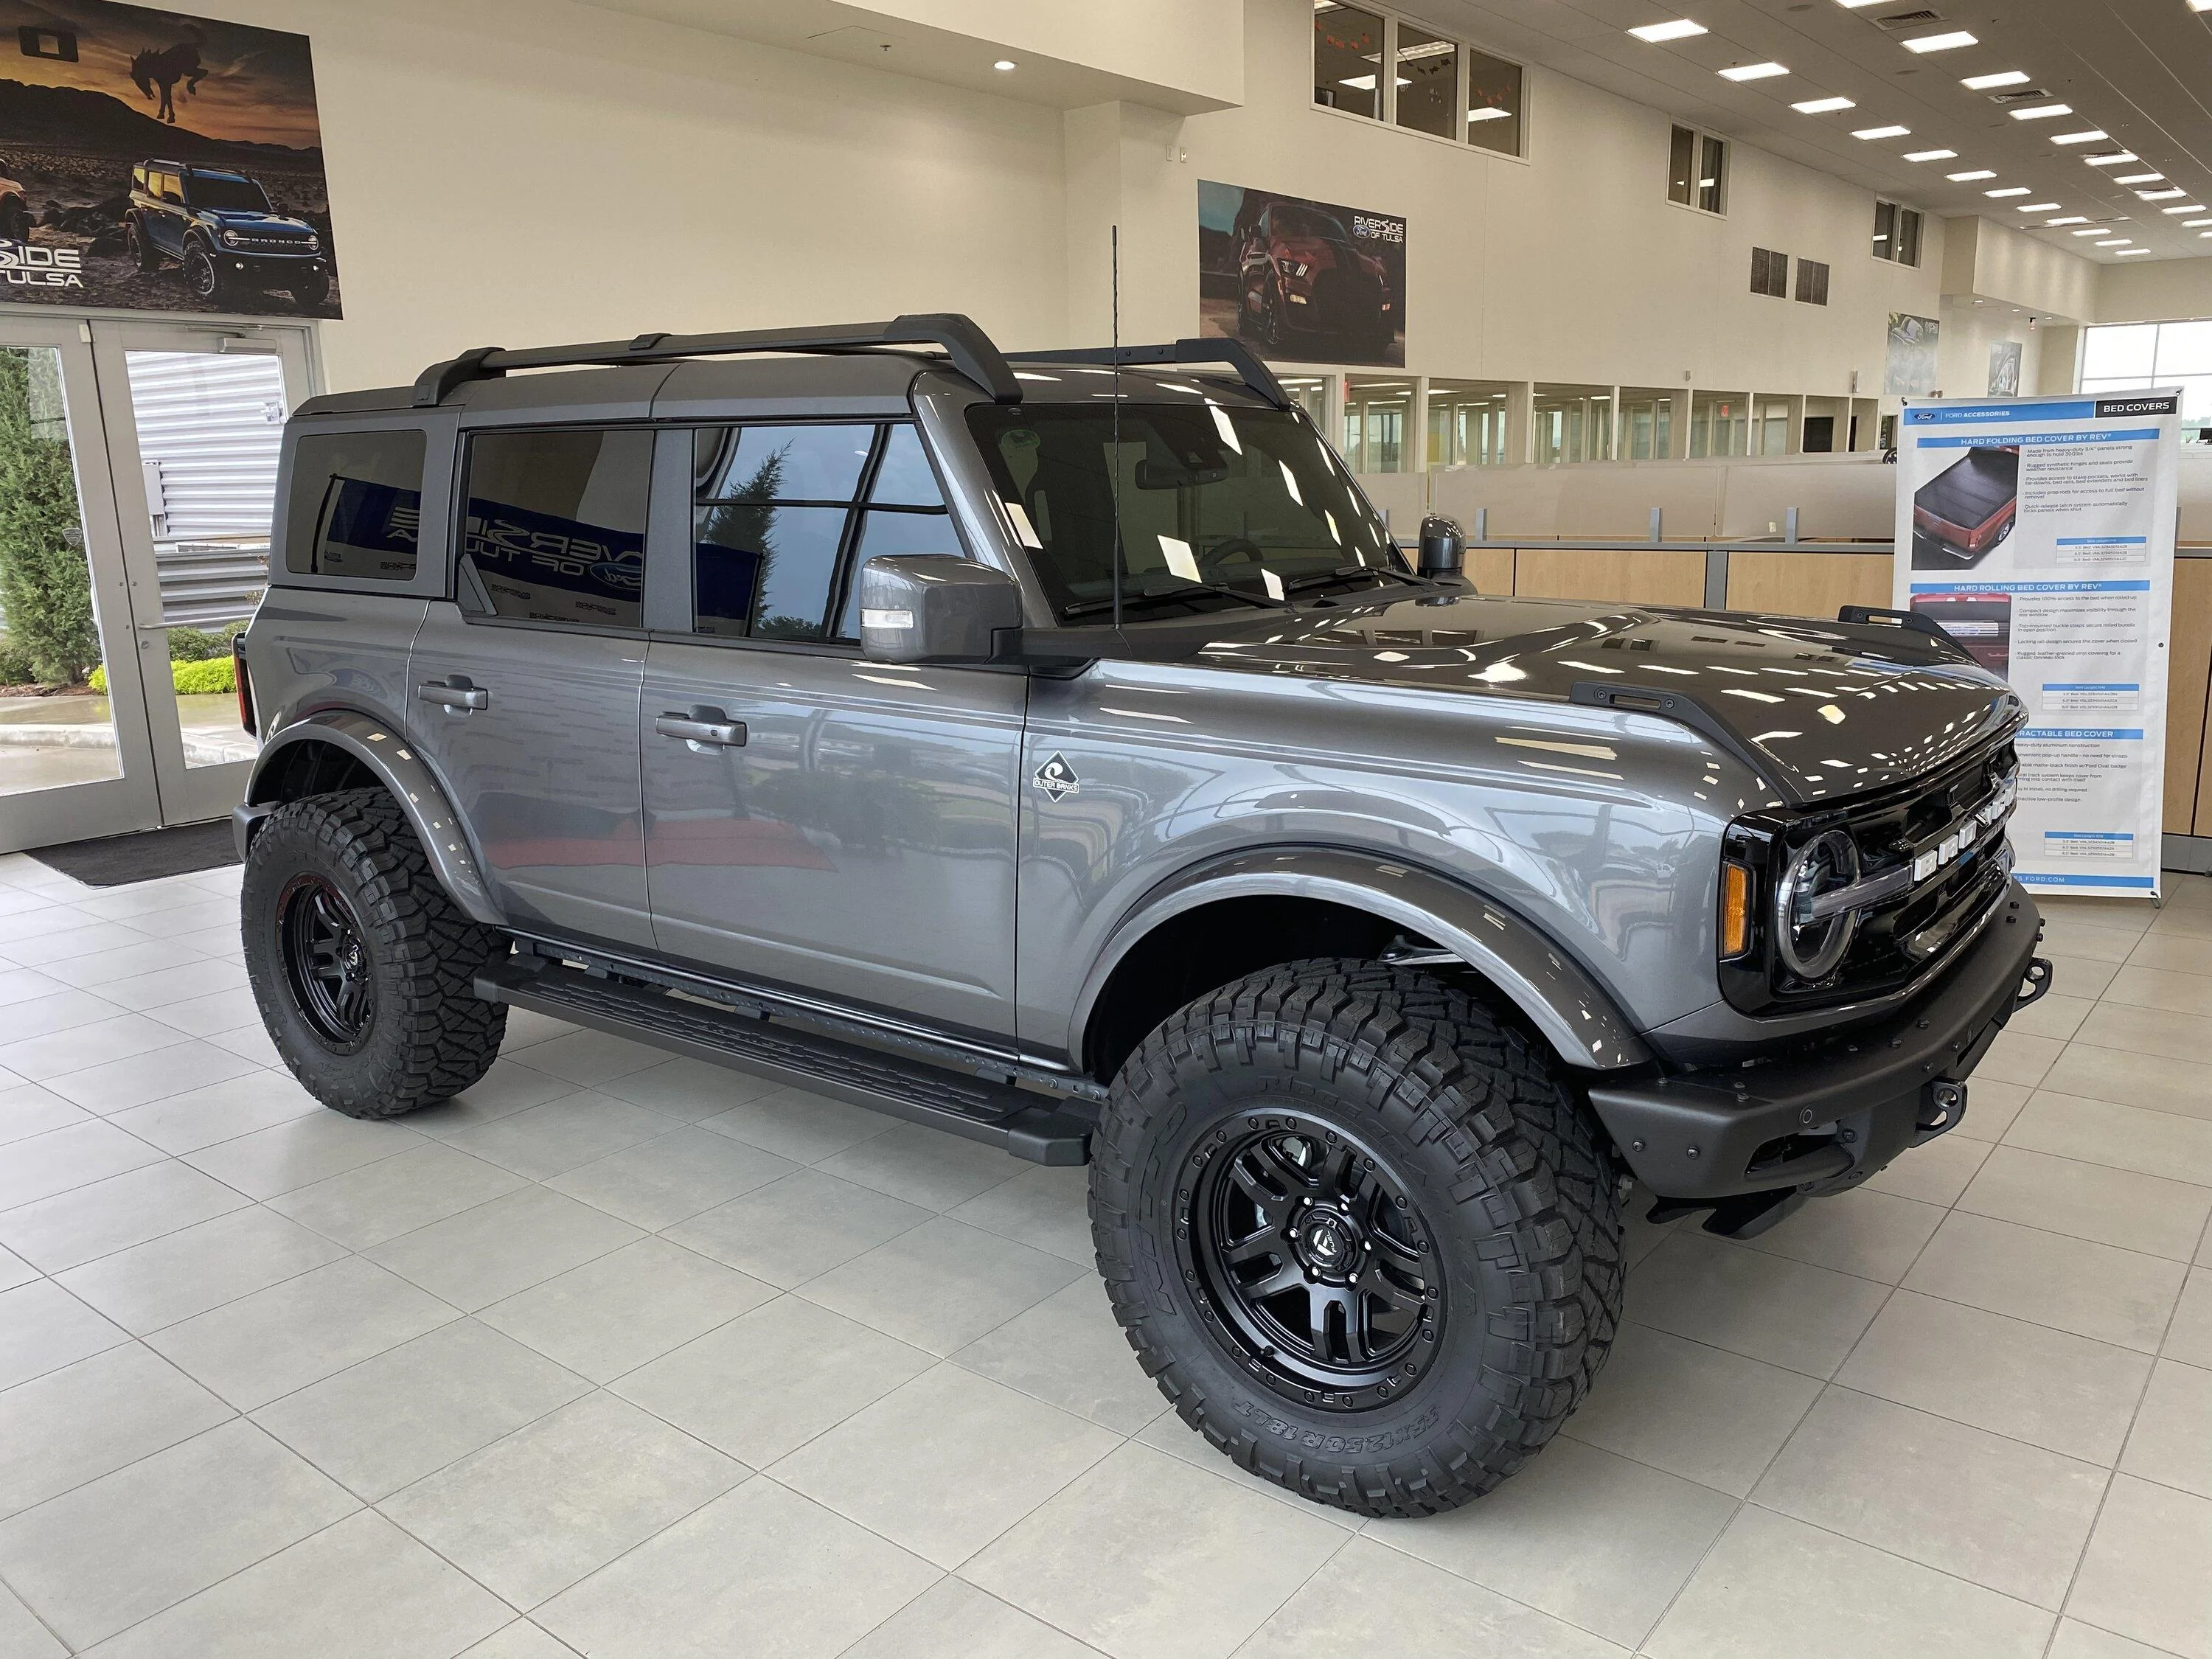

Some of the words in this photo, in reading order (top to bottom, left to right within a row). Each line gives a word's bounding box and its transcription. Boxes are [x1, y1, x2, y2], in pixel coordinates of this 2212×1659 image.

[1354, 215, 1404, 234] RIVERSIDE
[1382, 234, 1404, 243] TULSA
[2104, 405, 2124, 413] BED
[2126, 401, 2170, 412] COVERS
[1986, 437, 2023, 445] FOLDING
[2044, 434, 2075, 442] COVER
[1056, 782, 1078, 791] BANKS
